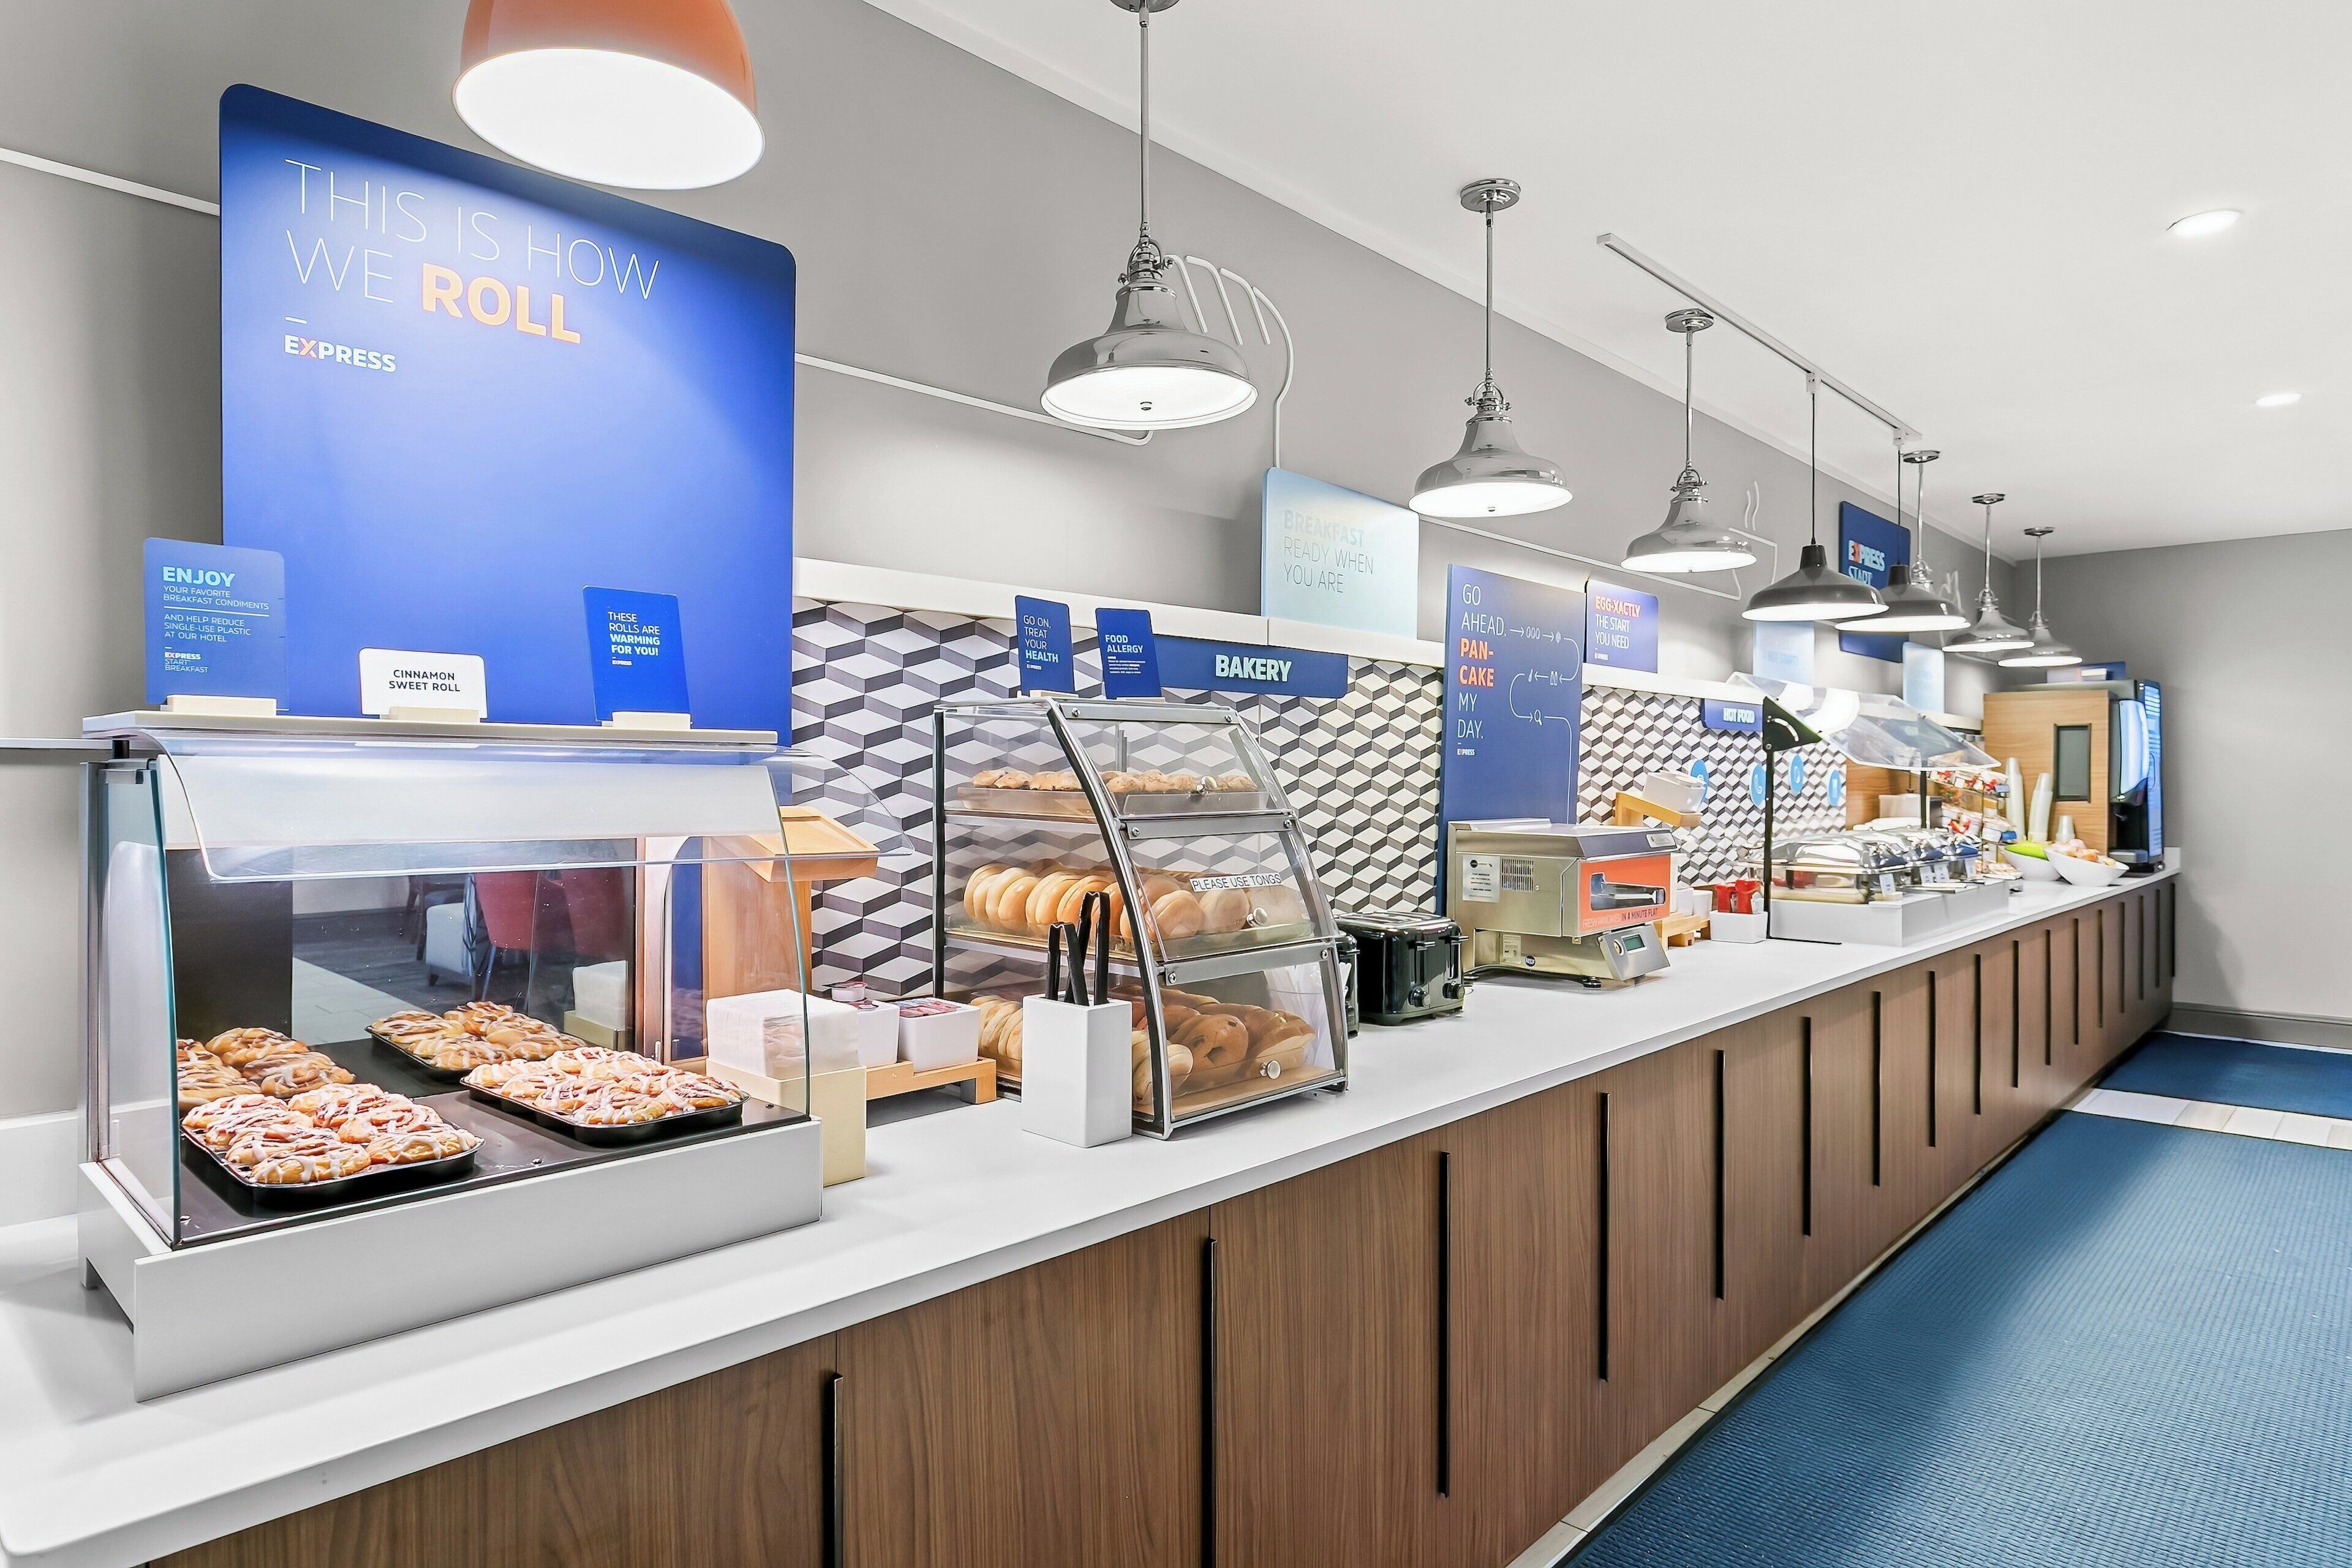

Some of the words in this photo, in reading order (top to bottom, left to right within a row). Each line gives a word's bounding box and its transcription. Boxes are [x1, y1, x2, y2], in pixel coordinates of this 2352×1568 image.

[285, 159, 428, 244] THIS
[458, 205, 501, 262] IS
[528, 225, 660, 300] HOW
[285, 228, 394, 304] WE
[421, 262, 581, 344] ROLL
[284, 334, 397, 372] EXPRESS
[1284, 509, 1365, 548] BREAKFAST
[1284, 536, 1329, 564] READY
[1335, 549, 1374, 575] WHEN
[162, 566, 235, 587] ENJOY
[1284, 562, 1313, 587] YOU
[1318, 570, 1344, 593] ARE
[164, 585, 188, 594] YOUR
[190, 587, 231, 598] FAVORITE
[1463, 583, 1481, 606] GO
[164, 594, 213, 605] BREAKFAST
[215, 598, 270, 610] CONDIMENTS
[211, 617, 245, 627] REDUCE
[608, 611, 638, 622] THESE
[1023, 615, 1035, 625] GO
[1037, 617, 1051, 629] ON,
[1461, 611, 1507, 636] AHEAD.
[1596, 614, 1608, 629] THE
[1610, 616, 1630, 633] START
[164, 622, 215, 633] SINGLE-USE
[217, 627, 251, 636] PLASTIC
[609, 623, 639, 634] ROLLS
[642, 625, 660, 635] ARE
[1024, 627, 1047, 638] TREAT
[200, 633, 227, 643] HOTEL
[610, 633, 660, 646] WARMING
[1025, 639, 1047, 650] YOUR
[1105, 635, 1128, 643] FOOD
[1595, 631, 1610, 646] YOU
[1611, 633, 1630, 649] NEED
[611, 644, 631, 654] FOR
[634, 646, 659, 656] YOU!
[1025, 649, 1059, 663] HEALTH
[1107, 644, 1143, 654] ALLERGY
[1460, 638, 1494, 660] PAN-
[165, 664, 208, 673] BREAKFAST
[393, 669, 455, 680] CINNAMON
[1215, 654, 1292, 682] BAKERY
[1459, 665, 1494, 687] CAKE
[389, 680, 428, 690] SWEET
[432, 683, 461, 692] ROLL
[1458, 692, 1478, 712] MY
[1723, 708, 1736, 722] HOT
[1737, 709, 1755, 723] FOOD
[1457, 719, 1483, 739] DAY.
[1193, 878, 1229, 890] PLEASE
[1230, 876, 1250, 888] USE
[1250, 874, 1282, 886] TONGS
[1631, 909, 1648, 919] MINUTE
